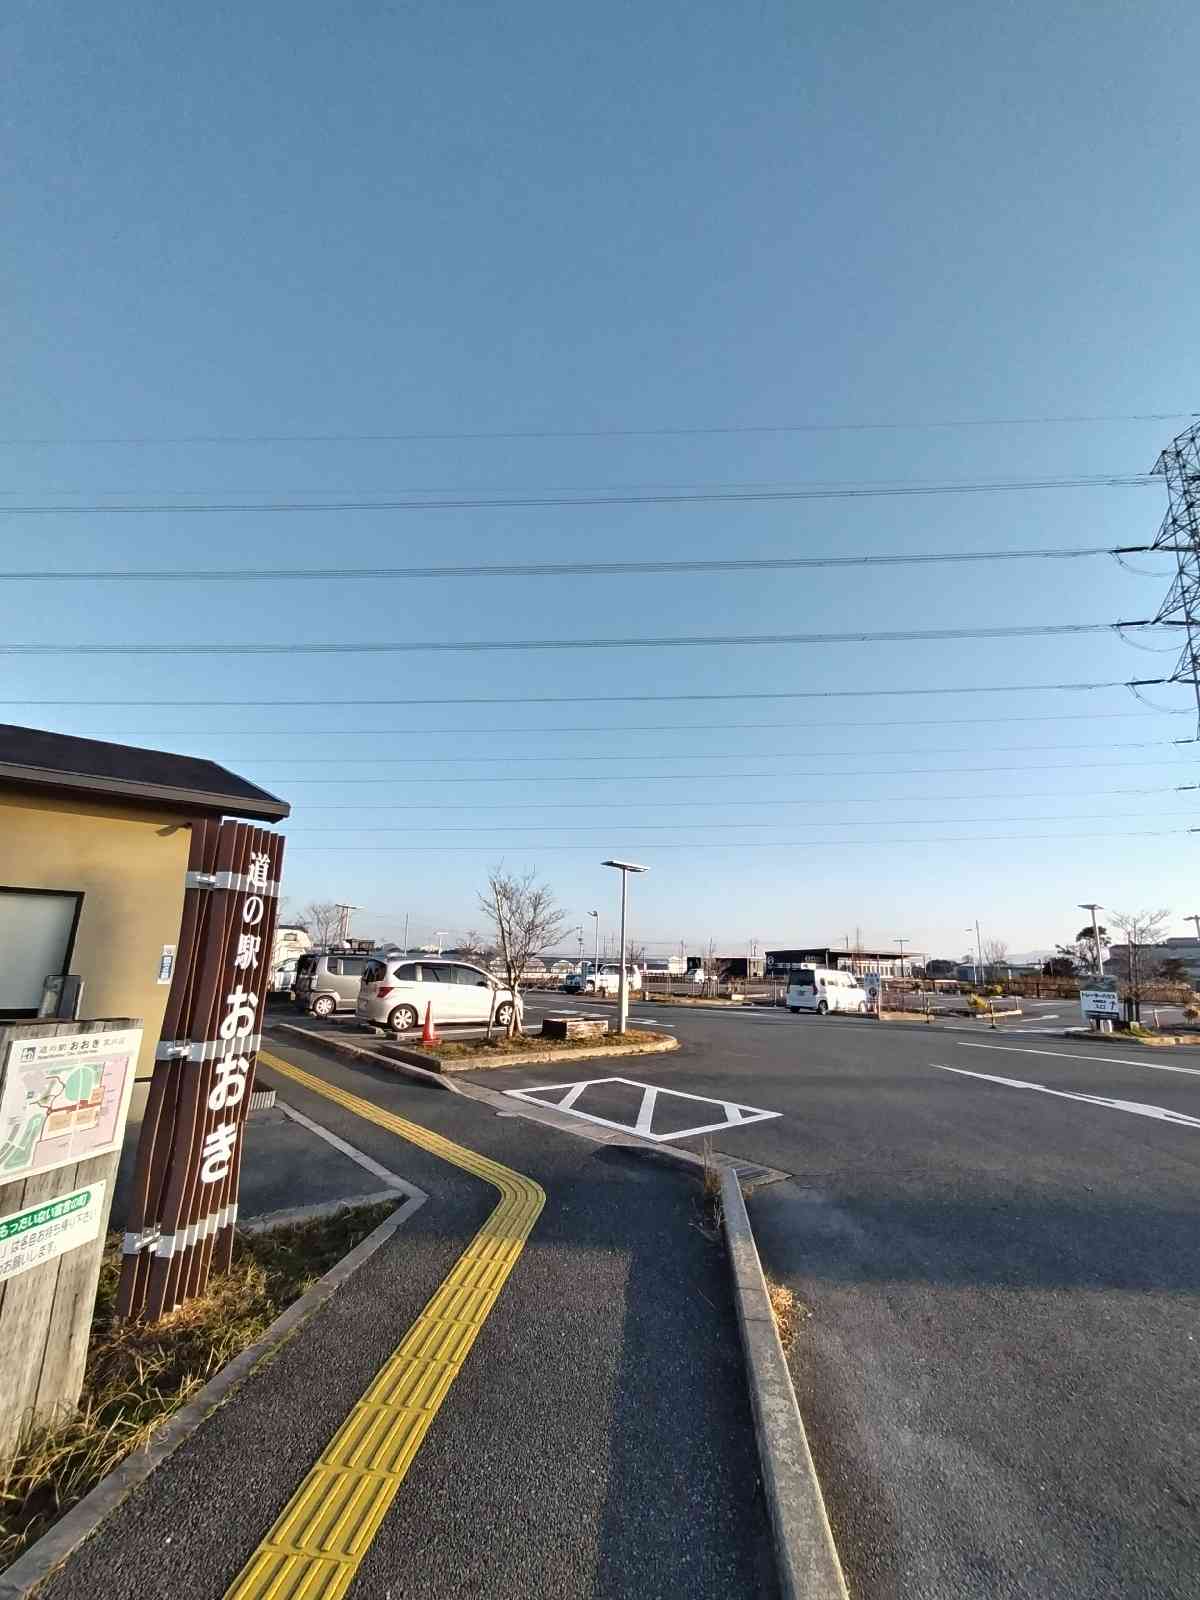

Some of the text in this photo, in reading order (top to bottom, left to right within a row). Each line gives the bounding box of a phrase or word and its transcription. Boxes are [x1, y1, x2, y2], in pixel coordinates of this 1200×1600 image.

[70, 1039, 99, 1051] おおき
[201, 851, 271, 1184] 道の駅 おおき
